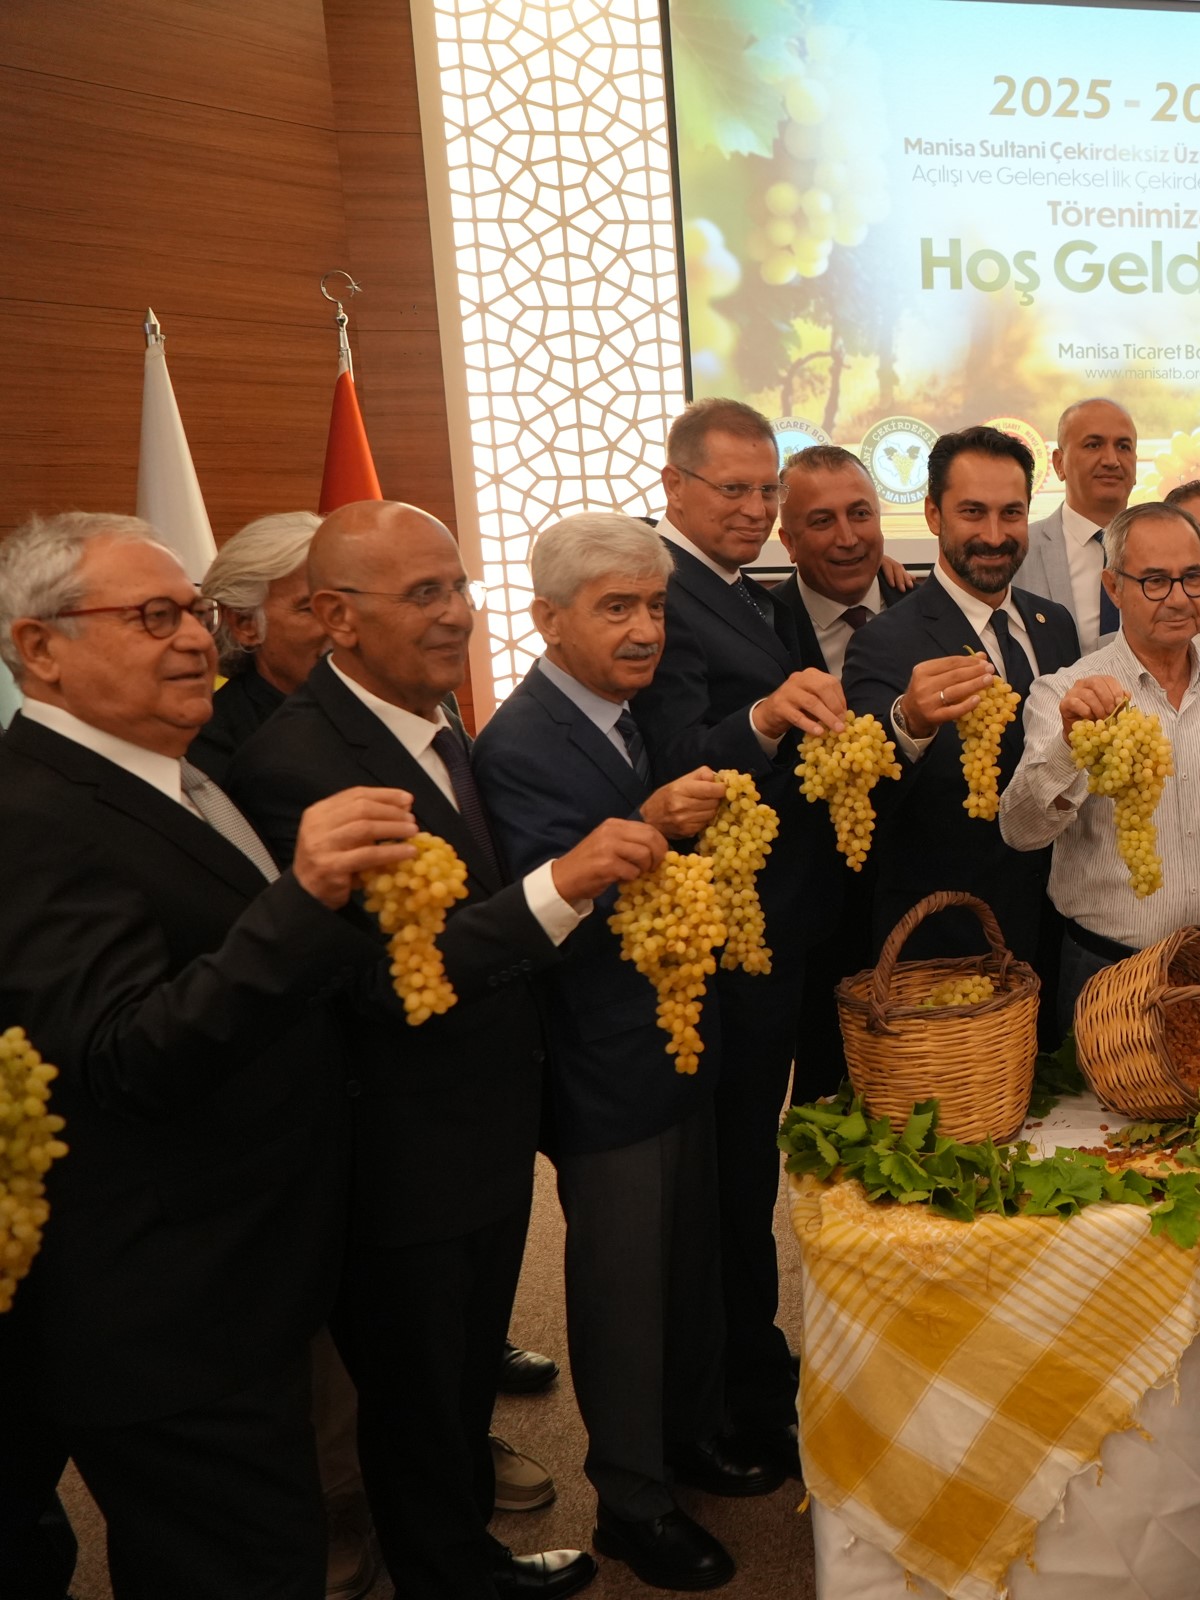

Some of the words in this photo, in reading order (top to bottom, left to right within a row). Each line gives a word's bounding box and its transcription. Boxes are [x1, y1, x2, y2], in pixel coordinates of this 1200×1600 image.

[989, 74, 1112, 120] 2025
[903, 136, 976, 157] Manisa
[979, 138, 1046, 159] Sultani
[1050, 141, 1169, 165] Çekirdeksiz
[912, 164, 963, 187] Açılışı
[967, 169, 993, 184] ve
[996, 166, 1109, 188] Geleneksel
[920, 237, 1041, 307] Hoş
[1058, 342, 1119, 361] Manisa
[1122, 343, 1183, 361] Ticaret
[885, 490, 924, 504] MANİSA
